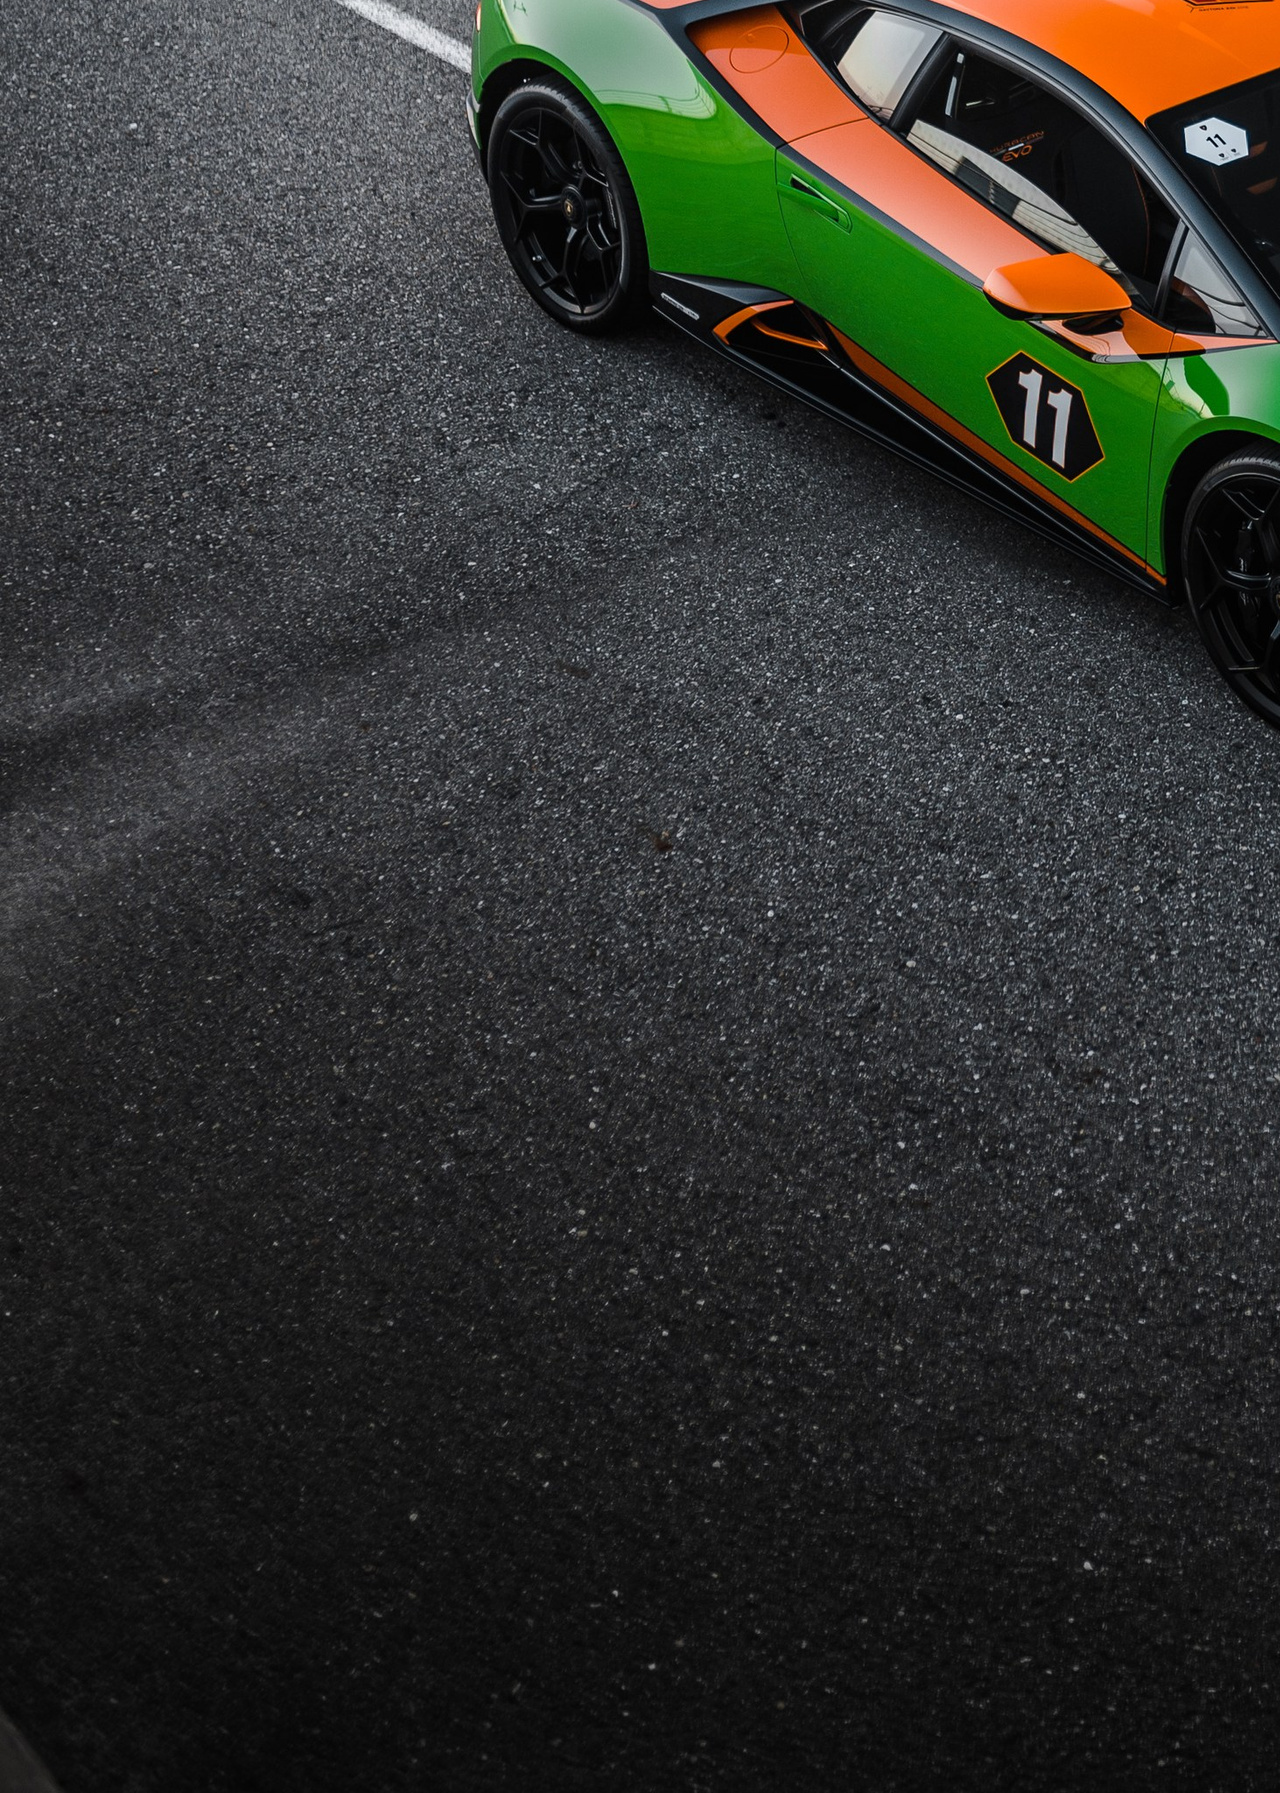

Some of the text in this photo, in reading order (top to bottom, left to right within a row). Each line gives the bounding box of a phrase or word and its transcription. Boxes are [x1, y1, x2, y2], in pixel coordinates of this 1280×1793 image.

[1206, 134, 1227, 148] 11
[1002, 144, 1033, 163] EVO
[1018, 368, 1073, 469] 11
